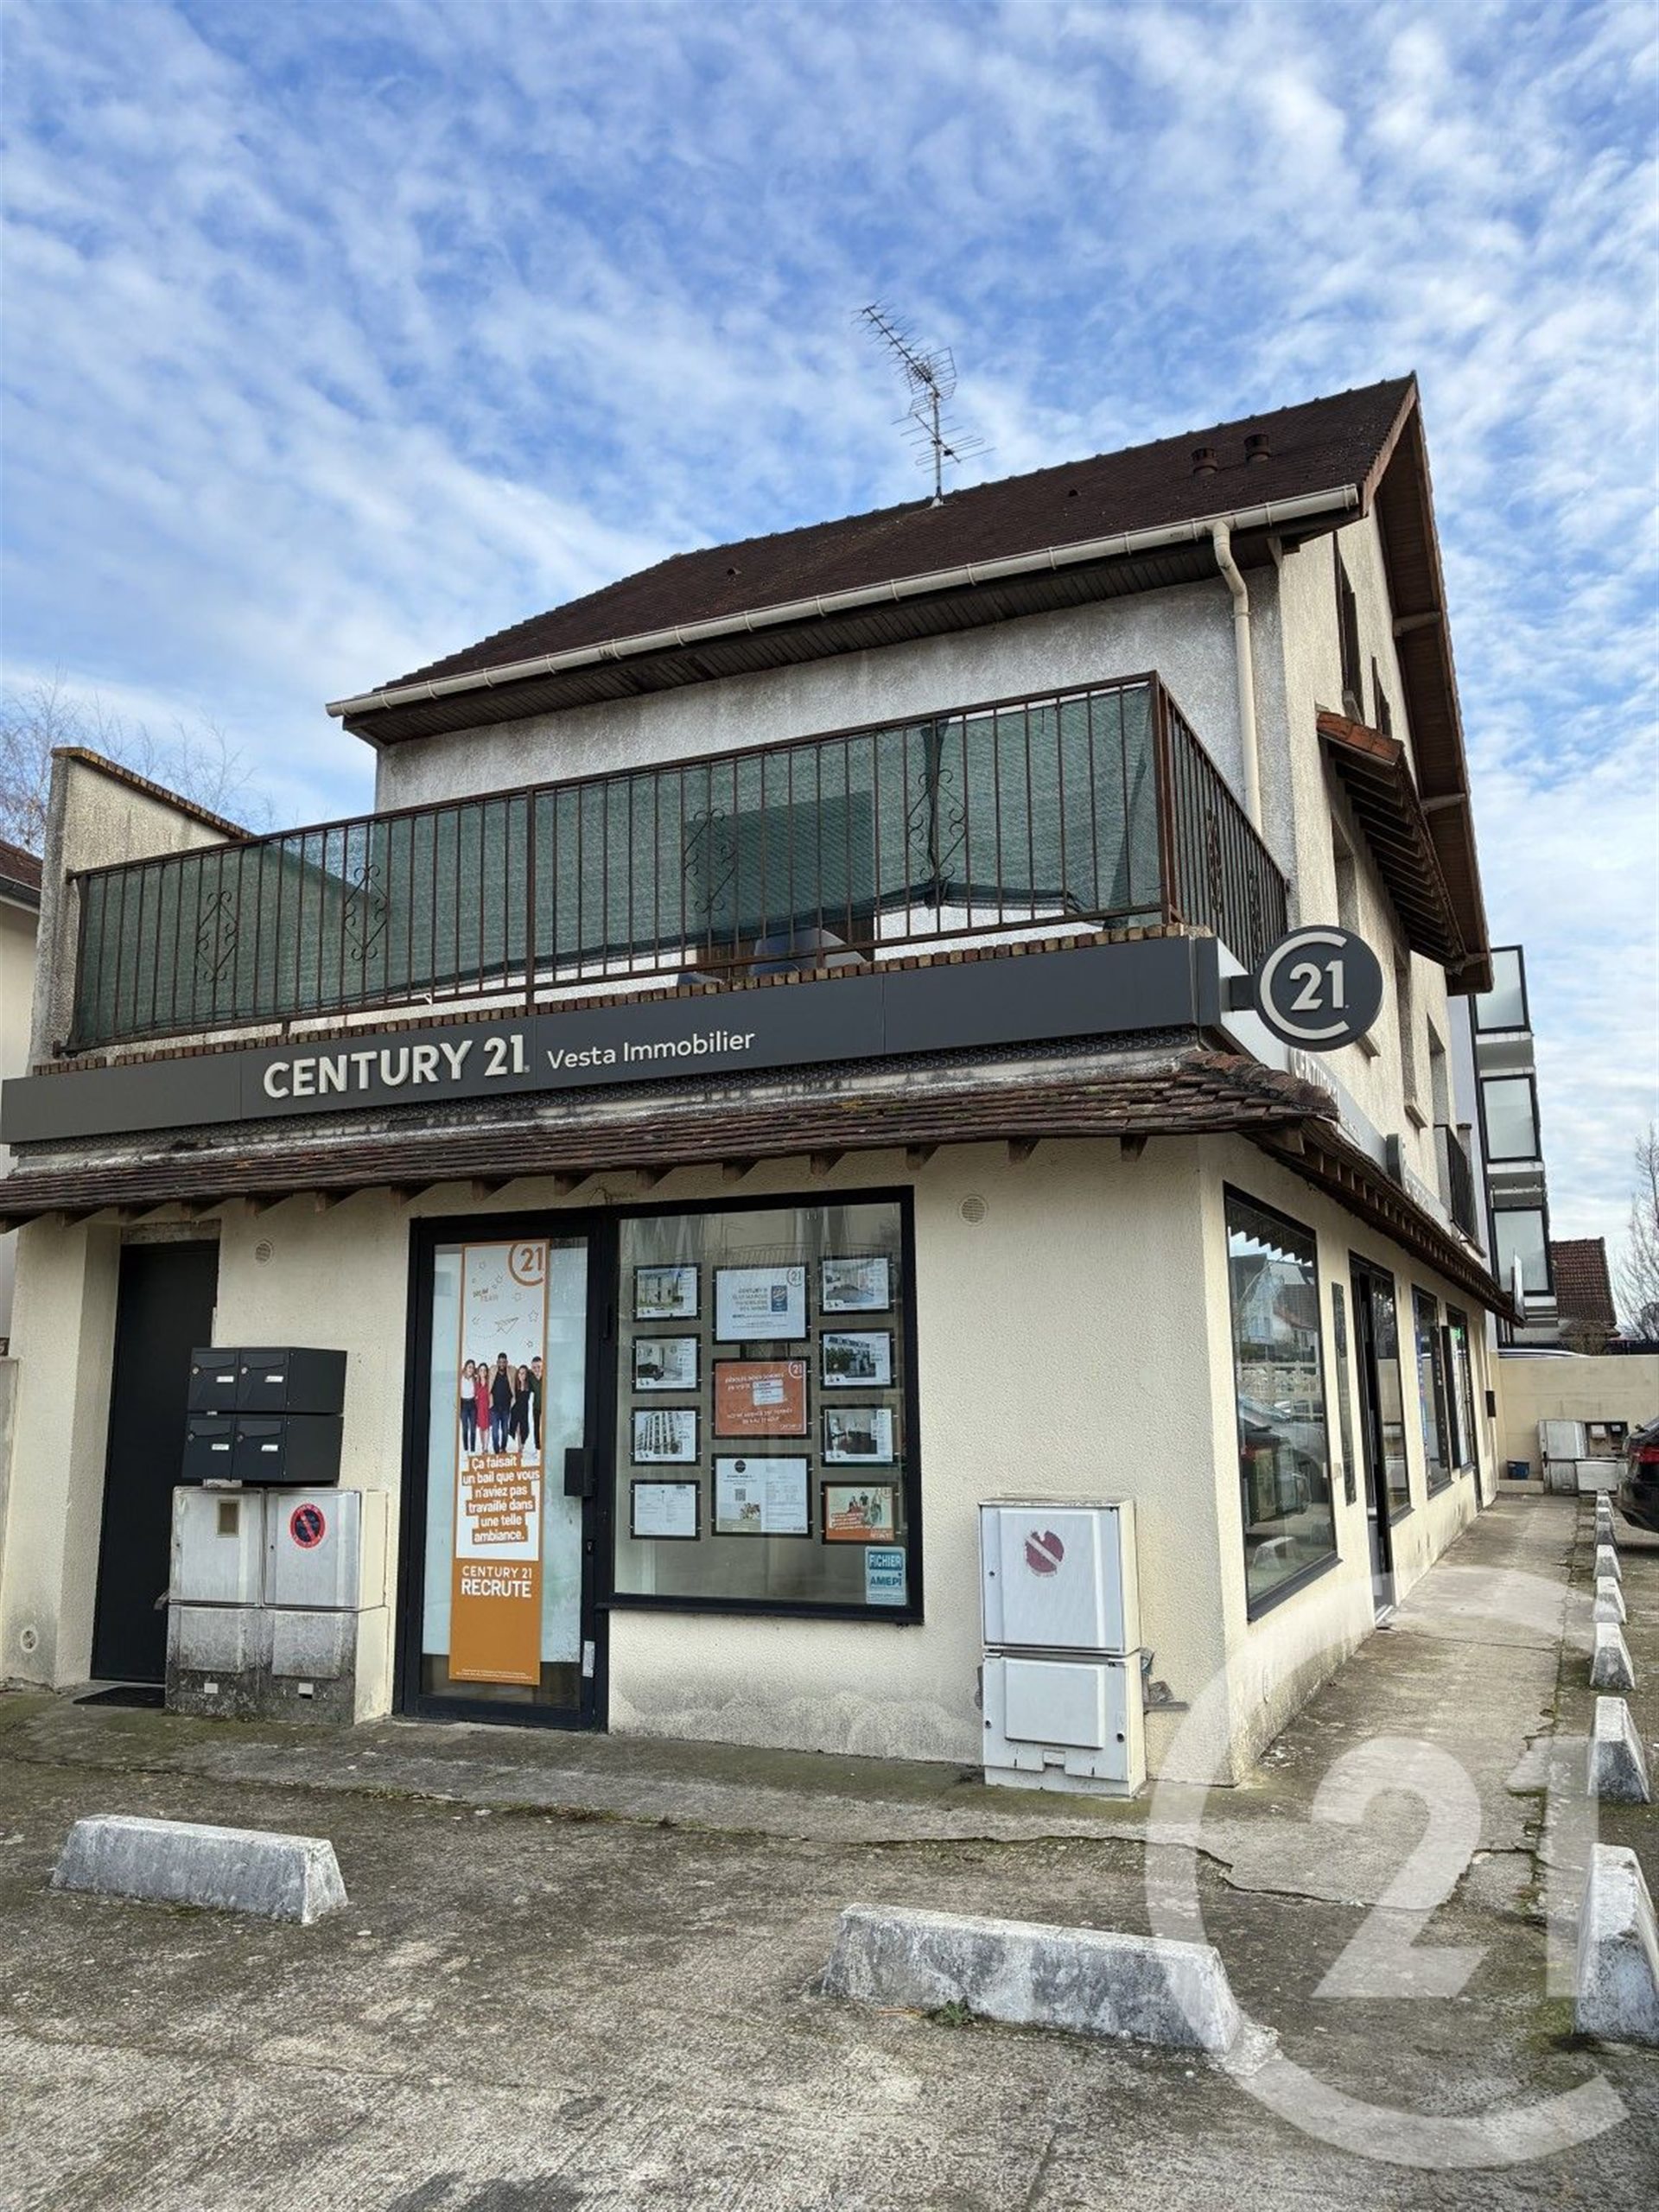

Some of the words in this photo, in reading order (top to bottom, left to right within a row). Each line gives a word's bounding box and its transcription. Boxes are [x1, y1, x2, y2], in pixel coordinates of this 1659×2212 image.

[1289, 960, 1344, 1011] 21
[263, 1039, 474, 1099] CENTURY
[483, 1033, 524, 1077] 21
[547, 1046, 617, 1070] Vesta
[623, 1030, 756, 1062] Immobilier
[520, 1246, 543, 1272] 21
[472, 1458, 485, 1471] Ça
[486, 1454, 518, 1468] faisait
[462, 1475, 476, 1484] un
[477, 1471, 495, 1484] bail
[496, 1472, 515, 1485] que
[516, 1470, 541, 1481] vous
[475, 1484, 508, 1498] n'aviez
[509, 1485, 528, 1499] pas
[467, 1498, 507, 1513] travaillé
[509, 1499, 534, 1511] dans
[480, 1516, 499, 1528] une
[500, 1513, 523, 1526] telle
[474, 1529, 525, 1543] ambiance.
[868, 1553, 903, 1568] FICHIER
[461, 1565, 519, 1579] CENTURY
[521, 1567, 533, 1580] 21
[461, 1578, 533, 1599] RECRUTE
